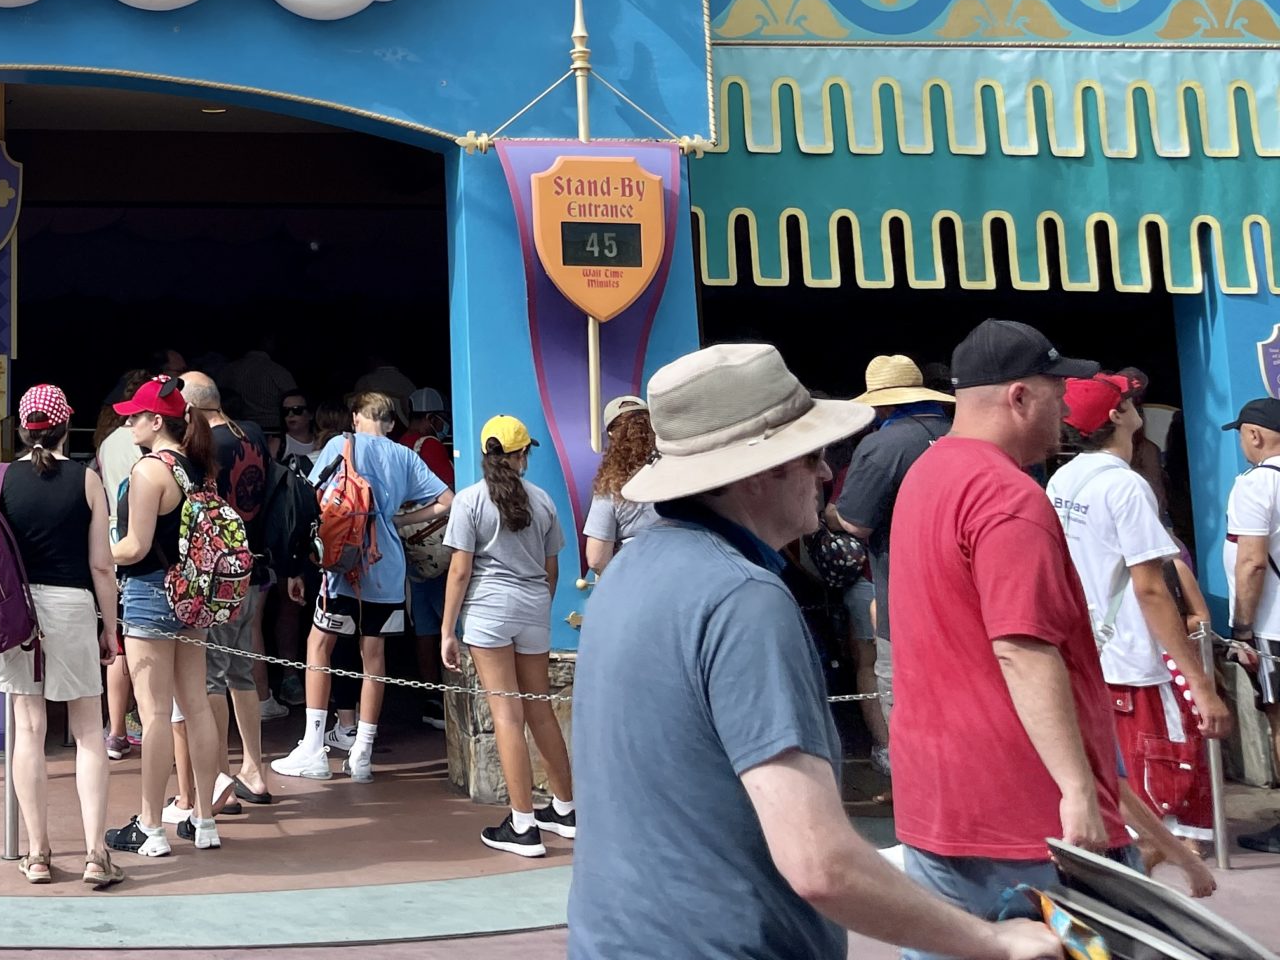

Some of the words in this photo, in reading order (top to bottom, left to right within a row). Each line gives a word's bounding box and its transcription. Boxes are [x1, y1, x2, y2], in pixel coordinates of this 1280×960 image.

[553, 176, 646, 201] Stand-By
[567, 201, 634, 218] Entrance
[586, 232, 618, 257] 45
[582, 269, 602, 278] Wait
[604, 269, 624, 278] Time
[587, 278, 620, 288] Minutes
